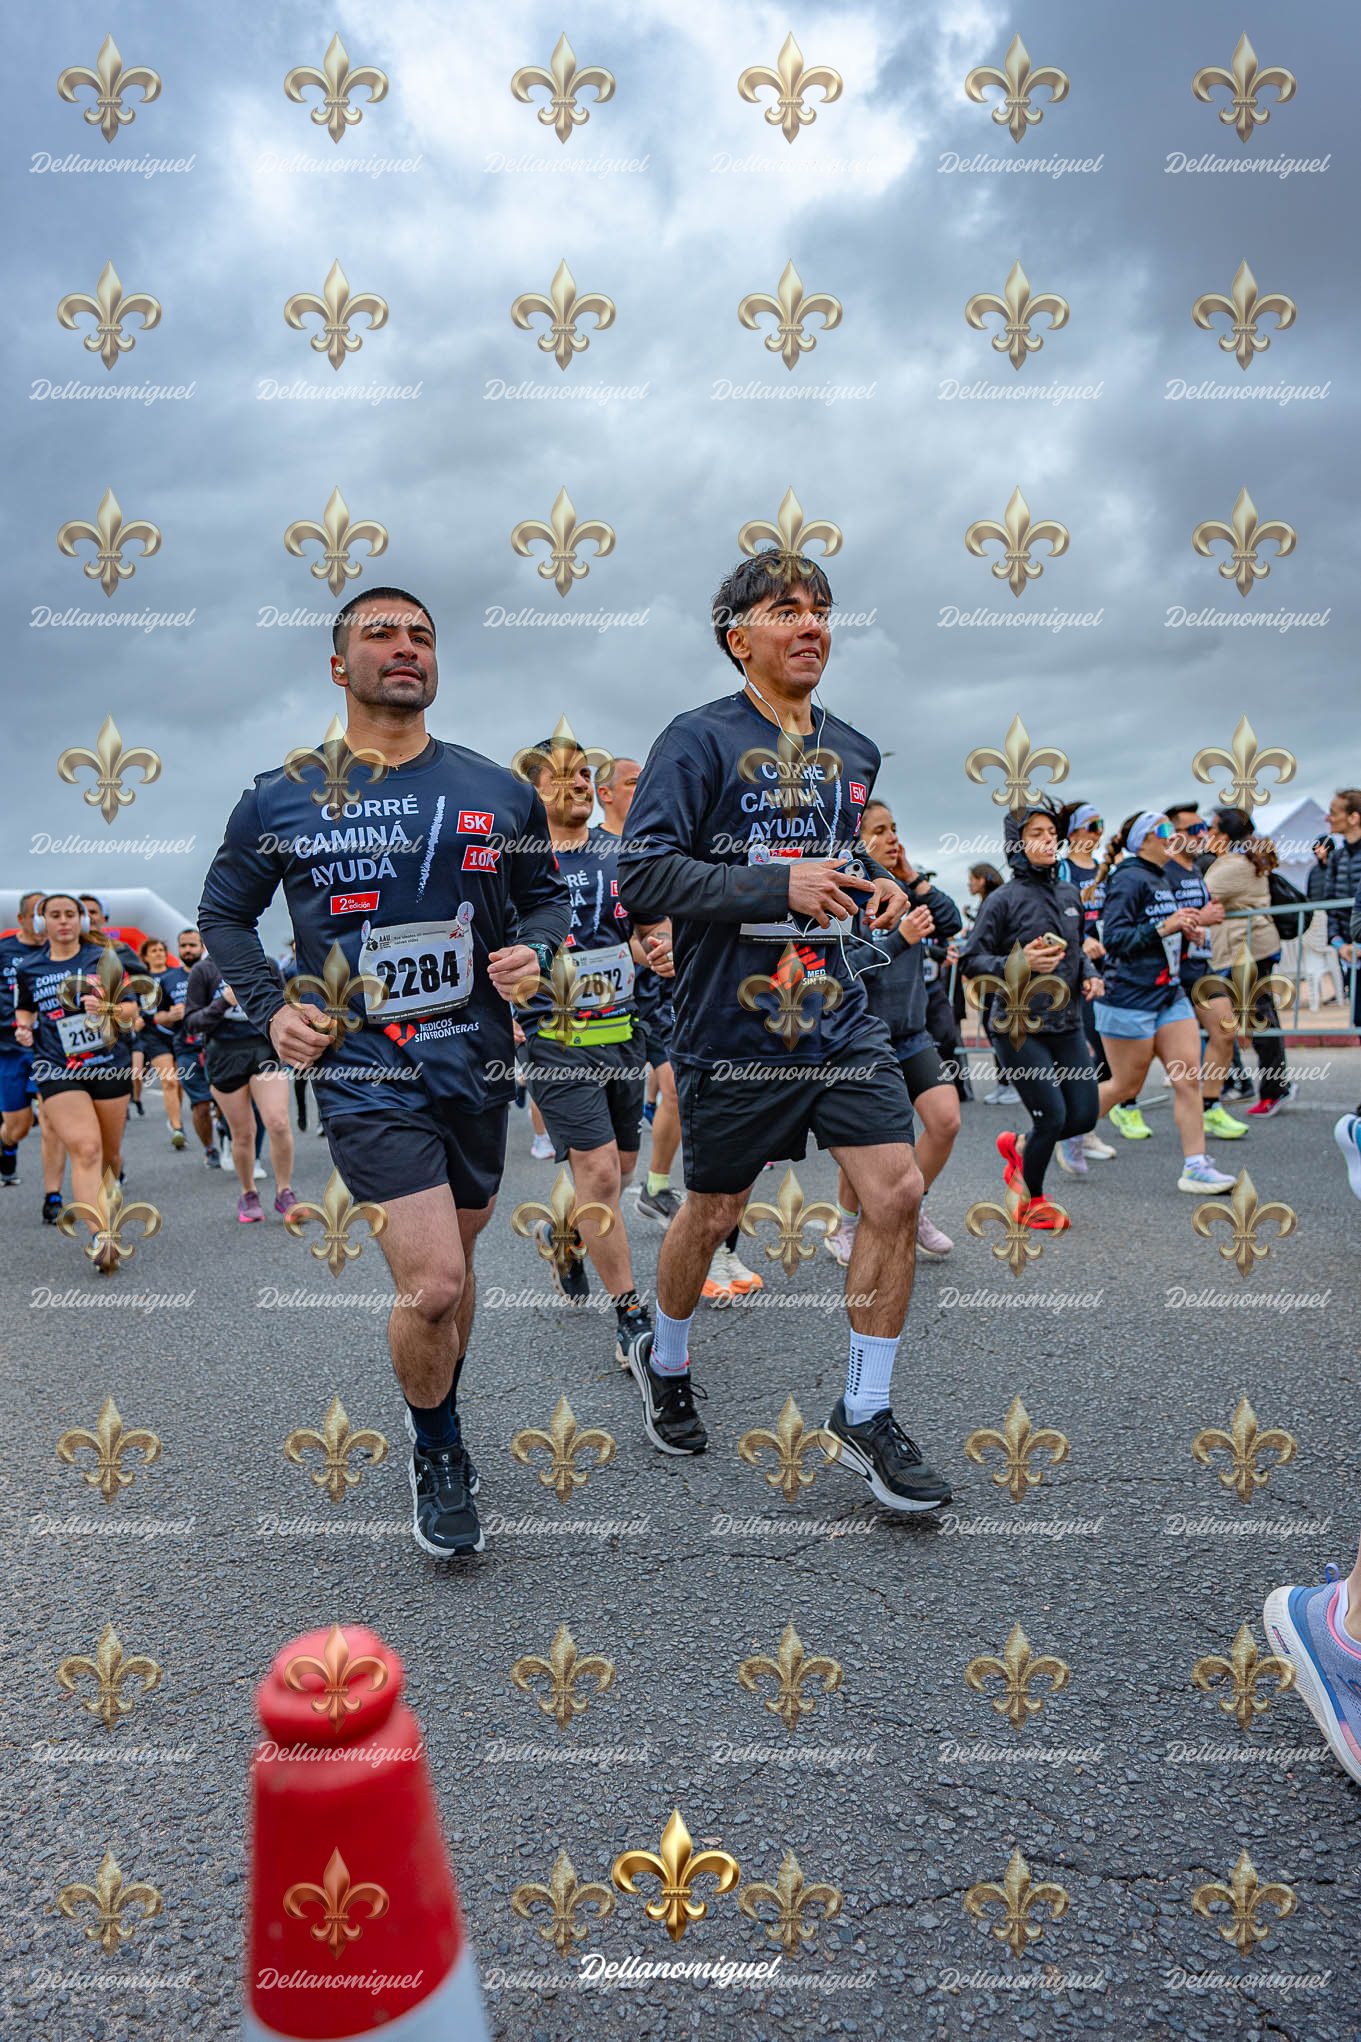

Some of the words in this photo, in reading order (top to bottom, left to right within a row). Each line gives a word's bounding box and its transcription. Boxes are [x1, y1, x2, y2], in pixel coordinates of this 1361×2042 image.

[321, 794, 419, 821] CORRÉ
[853, 787, 865, 801] 5K
[463, 815, 488, 832] 5K
[748, 813, 817, 843] AYUDÁ
[294, 820, 409, 859] CAMINÁ
[311, 853, 398, 887] AYUDÁ
[376, 950, 460, 999] 2284
